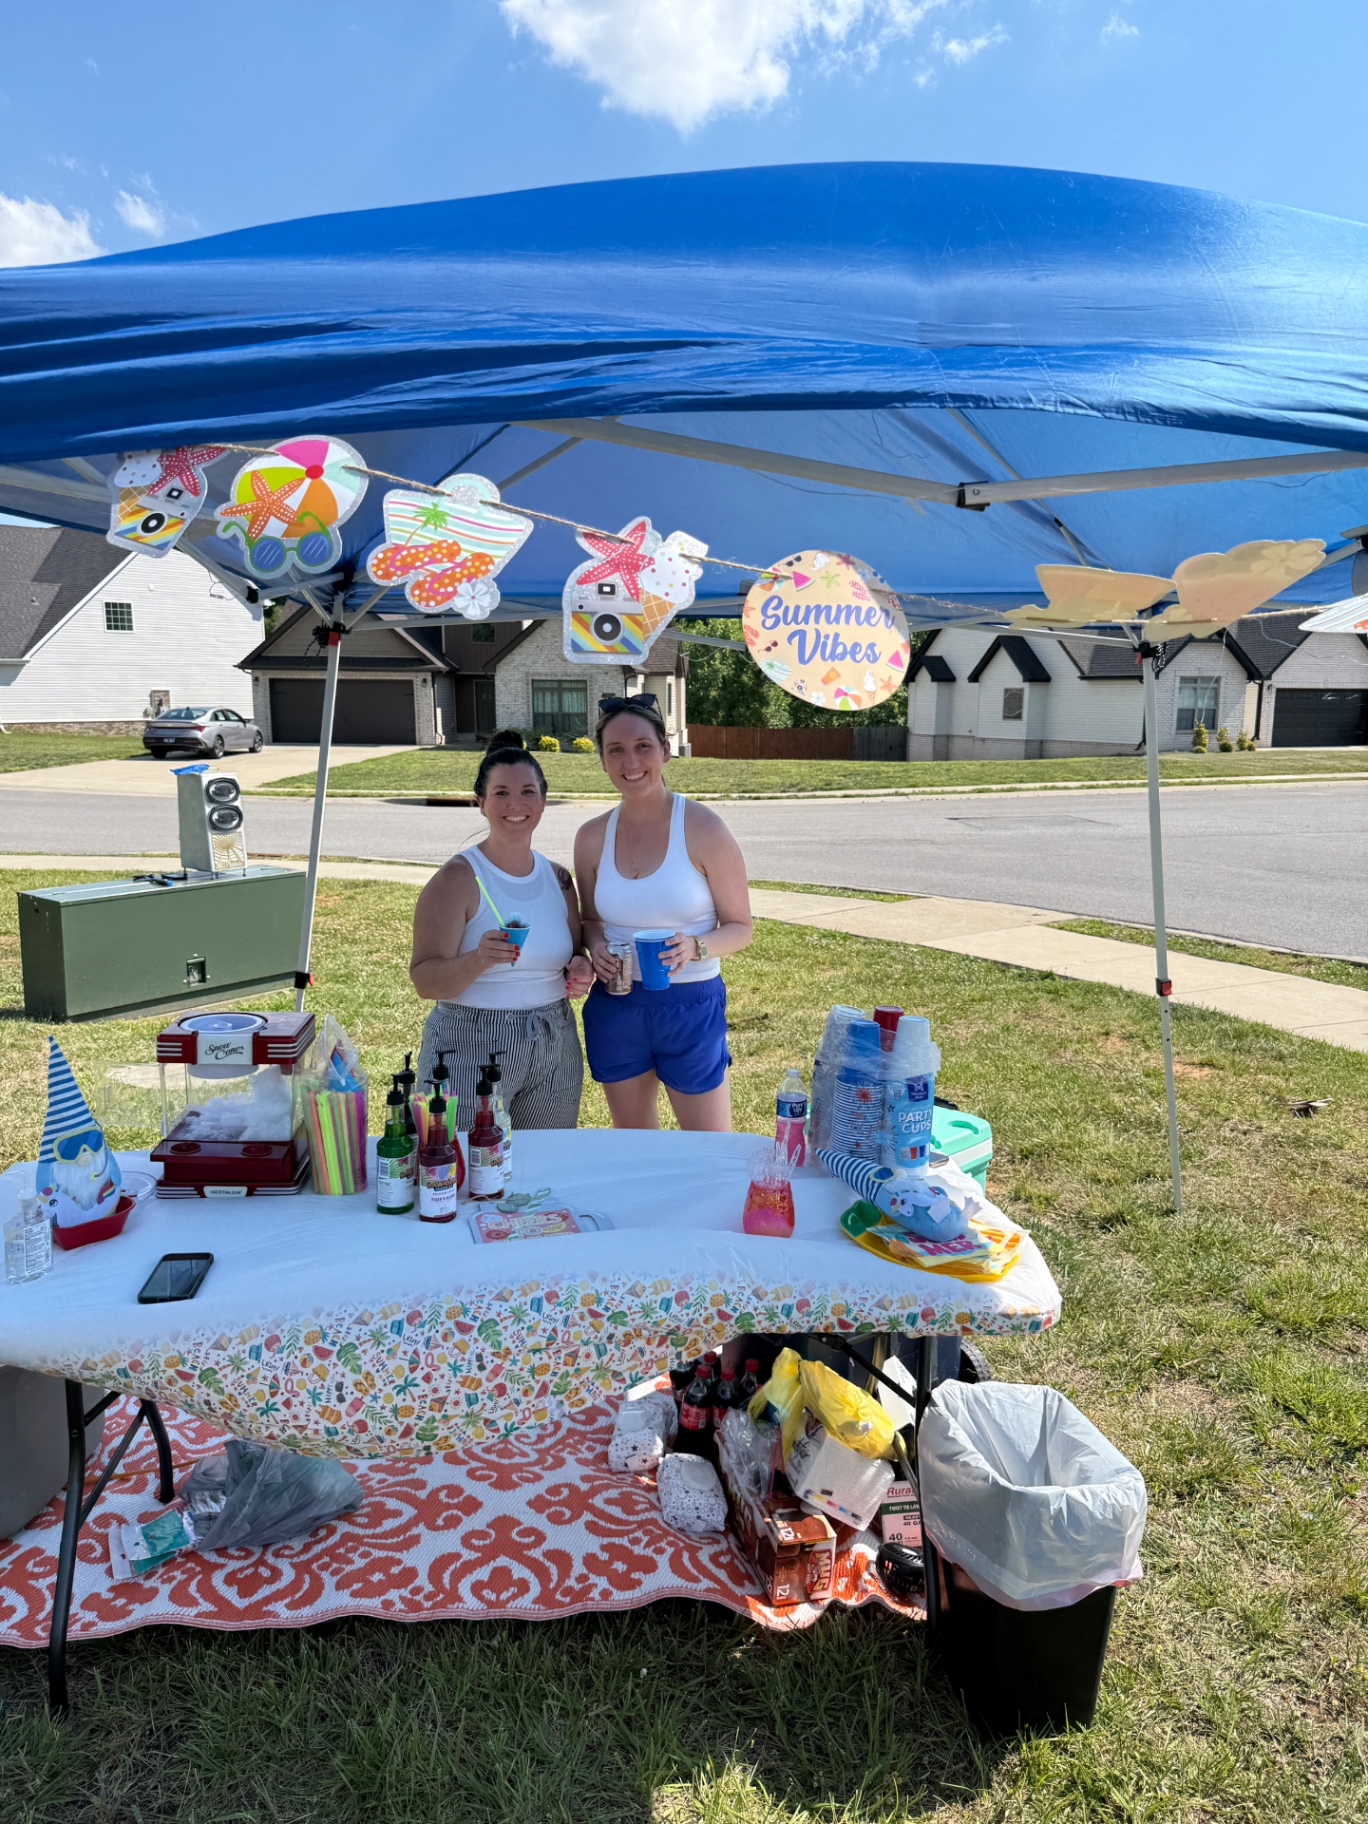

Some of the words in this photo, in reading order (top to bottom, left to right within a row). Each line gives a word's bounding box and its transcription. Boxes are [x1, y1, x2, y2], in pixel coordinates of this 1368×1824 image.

[761, 595, 895, 630] Summer
[787, 628, 882, 666] Vibes
[205, 1042, 231, 1055] Snow
[215, 1046, 244, 1060] Cones
[898, 1108, 932, 1123] PARTY
[902, 1121, 931, 1134] CUPS
[487, 1213, 563, 1229] CHEERS
[515, 1225, 543, 1237] TO
[889, 1533, 903, 1541] 40
[812, 1551, 832, 1591] MUG
[777, 1584, 790, 1597] 12
